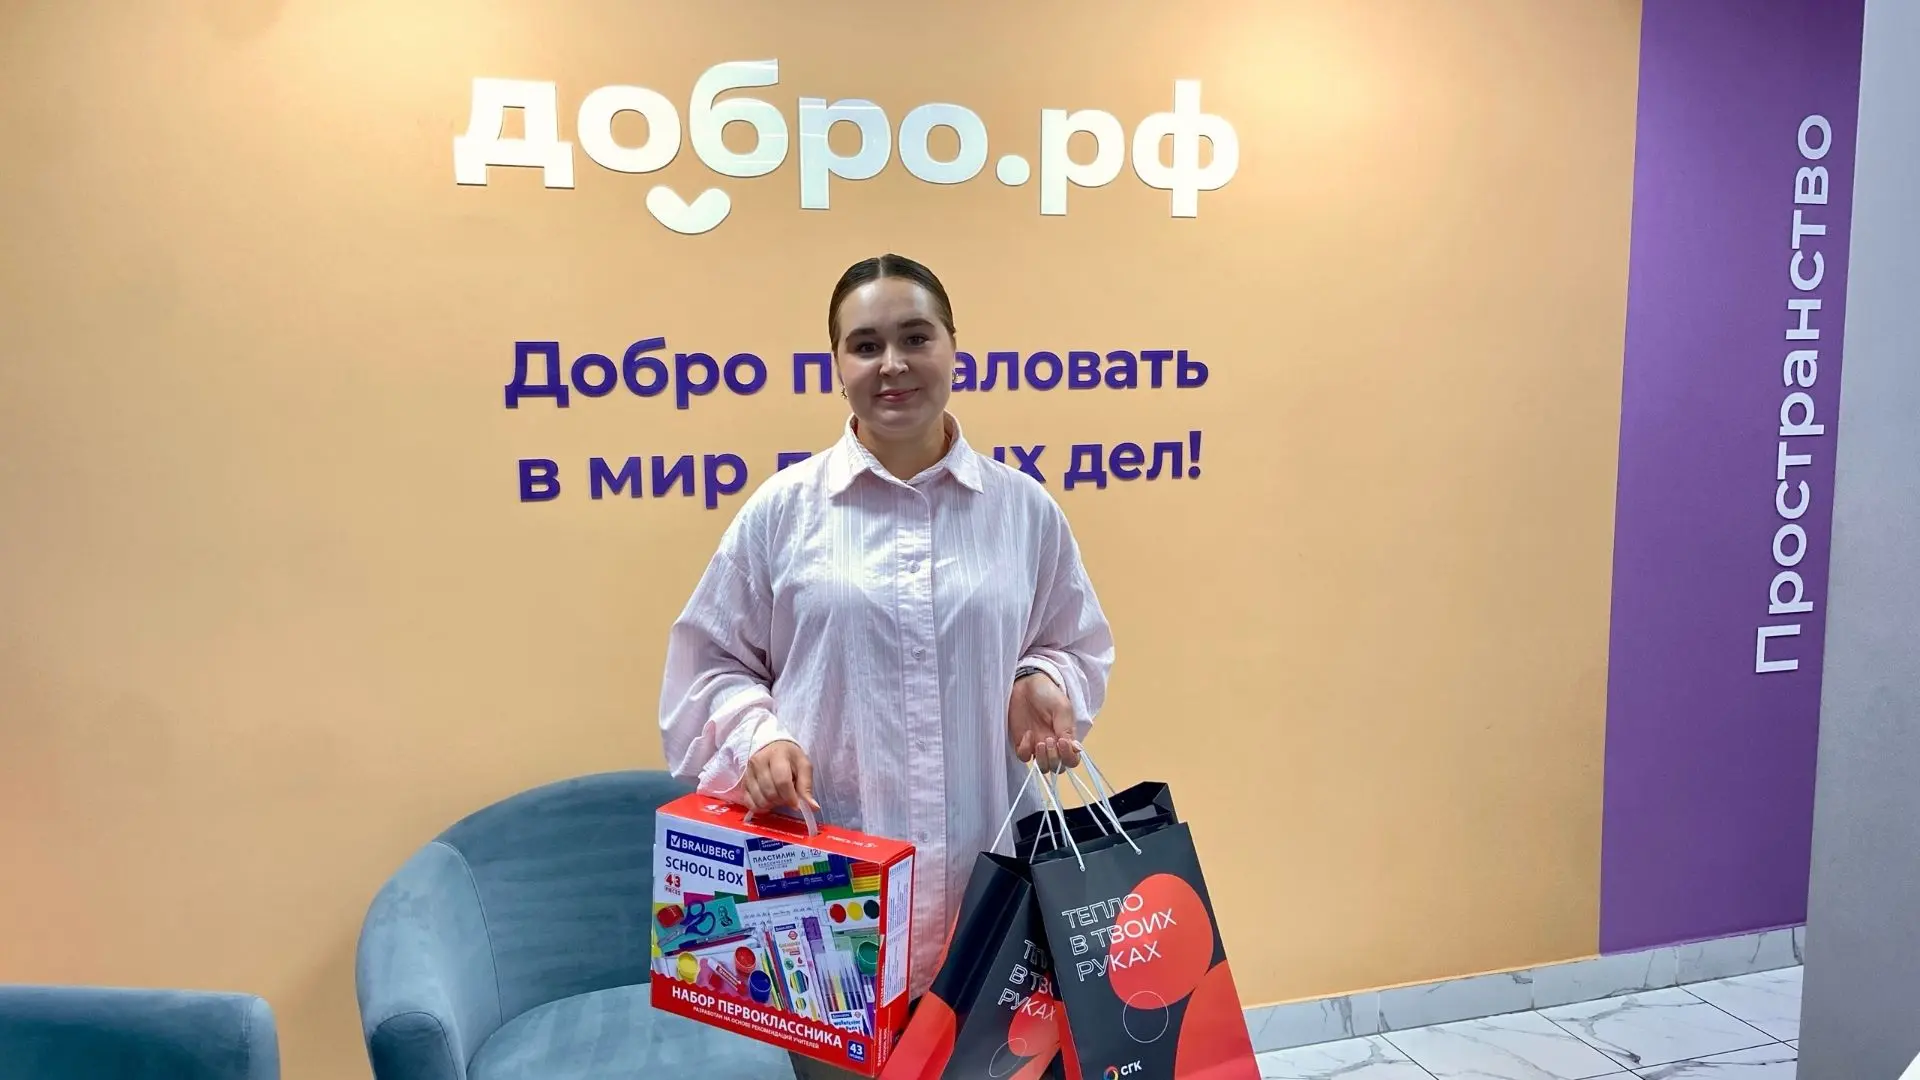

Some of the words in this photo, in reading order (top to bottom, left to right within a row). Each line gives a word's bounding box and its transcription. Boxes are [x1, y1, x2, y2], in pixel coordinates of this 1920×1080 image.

[453, 58, 1241, 217] добро.рф
[506, 338, 766, 408] Добро
[793, 349, 1208, 393] паловать
[1755, 114, 1832, 674] Пространство
[520, 458, 560, 501] в
[591, 454, 747, 508] мир
[1064, 430, 1202, 489] дел!
[681, 839, 735, 861] BRAUBERG
[665, 856, 714, 879] SCHOOL
[718, 869, 743, 886] BOX
[665, 874, 681, 888] 43
[1061, 893, 1144, 928] ТЕПЛО
[1069, 935, 1089, 956] В
[1090, 908, 1177, 948] ТВОИХ
[1009, 963, 1028, 985] В
[1076, 940, 1162, 982] РУКАХ
[672, 985, 715, 1008] НАБОР
[718, 999, 843, 1048] ПЕРВОКЛАССНИКА
[850, 1043, 863, 1055] 43
[1120, 1060, 1143, 1076] СГК
